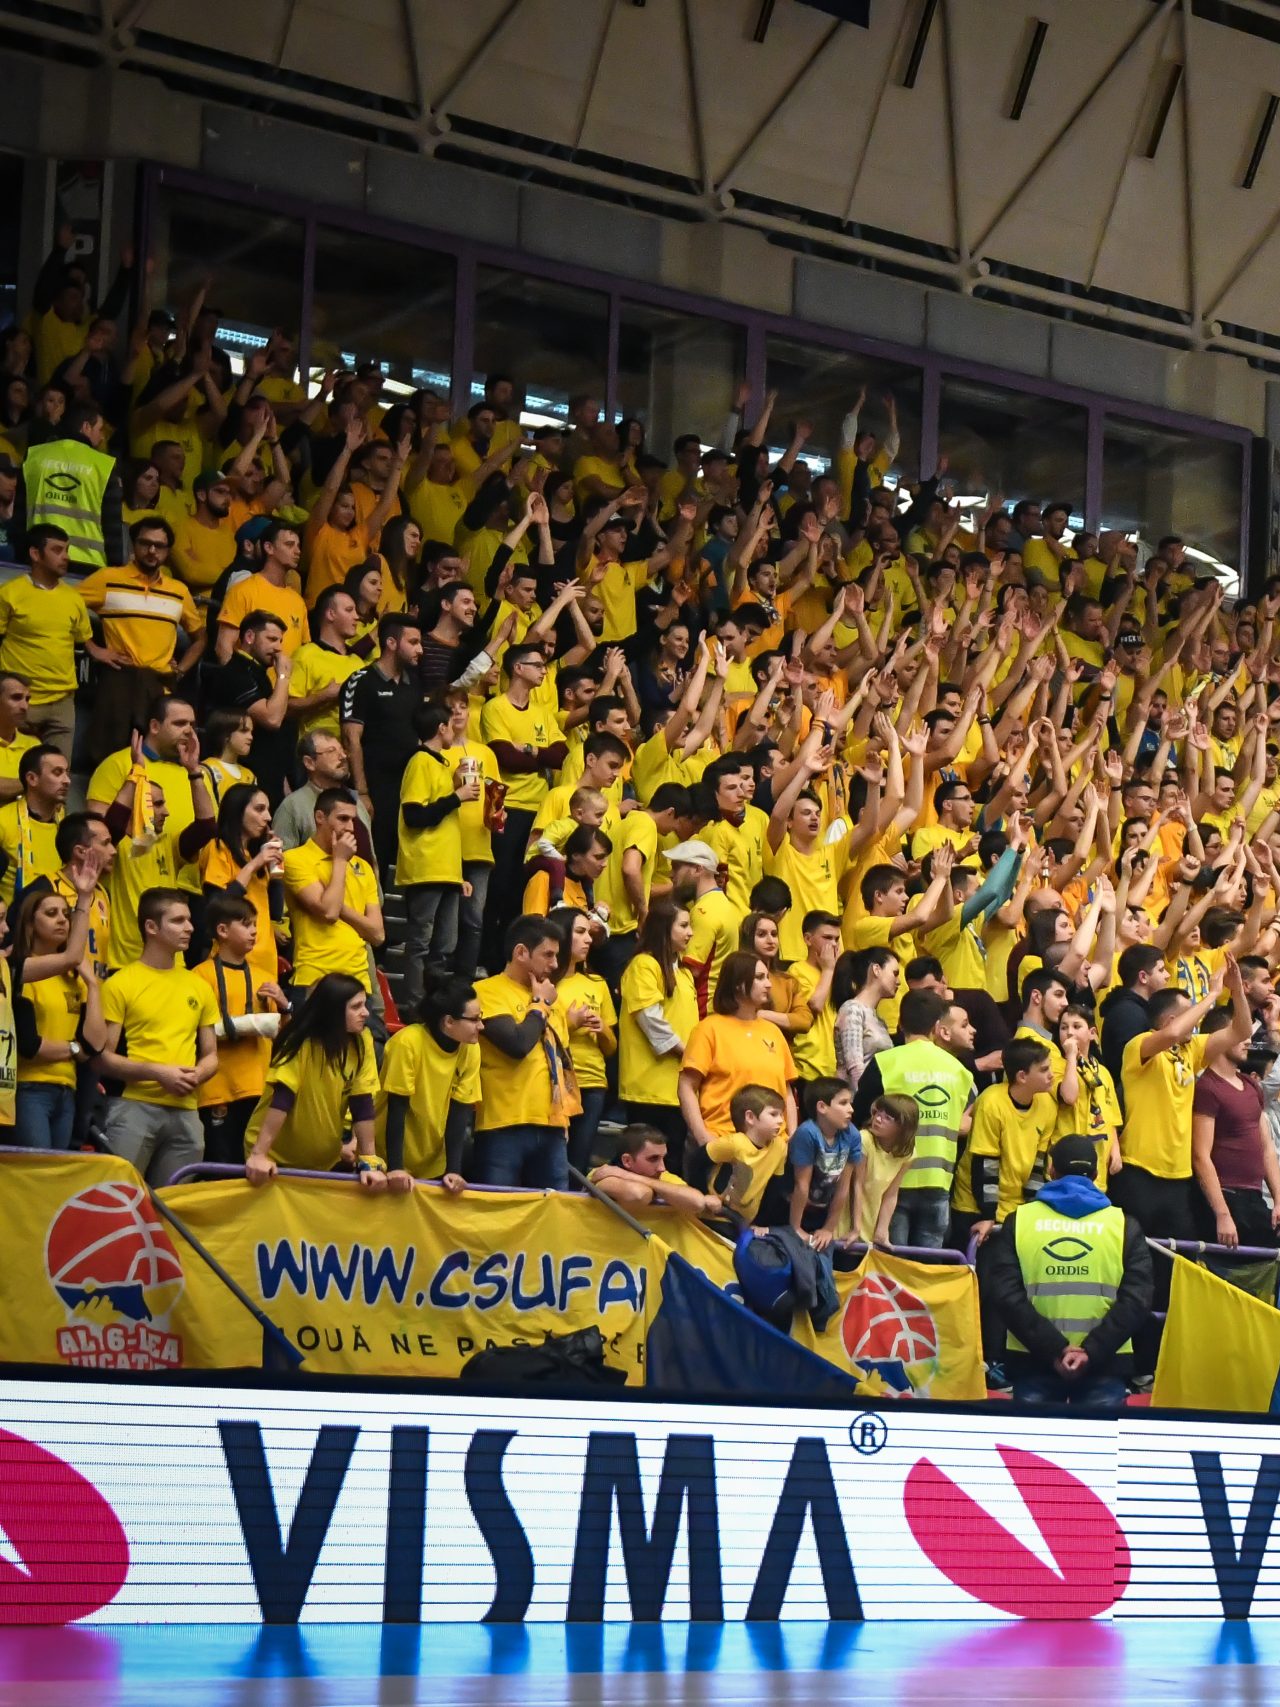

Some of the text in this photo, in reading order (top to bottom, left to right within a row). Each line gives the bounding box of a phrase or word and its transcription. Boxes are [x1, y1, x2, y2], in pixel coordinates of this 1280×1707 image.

[1035, 1219, 1104, 1234] SECURITY
[59, 1328, 97, 1354] AL
[278, 1325, 372, 1353] OUĂ
[391, 1334, 439, 1356] NE
[217, 1419, 865, 1624] VISMA
